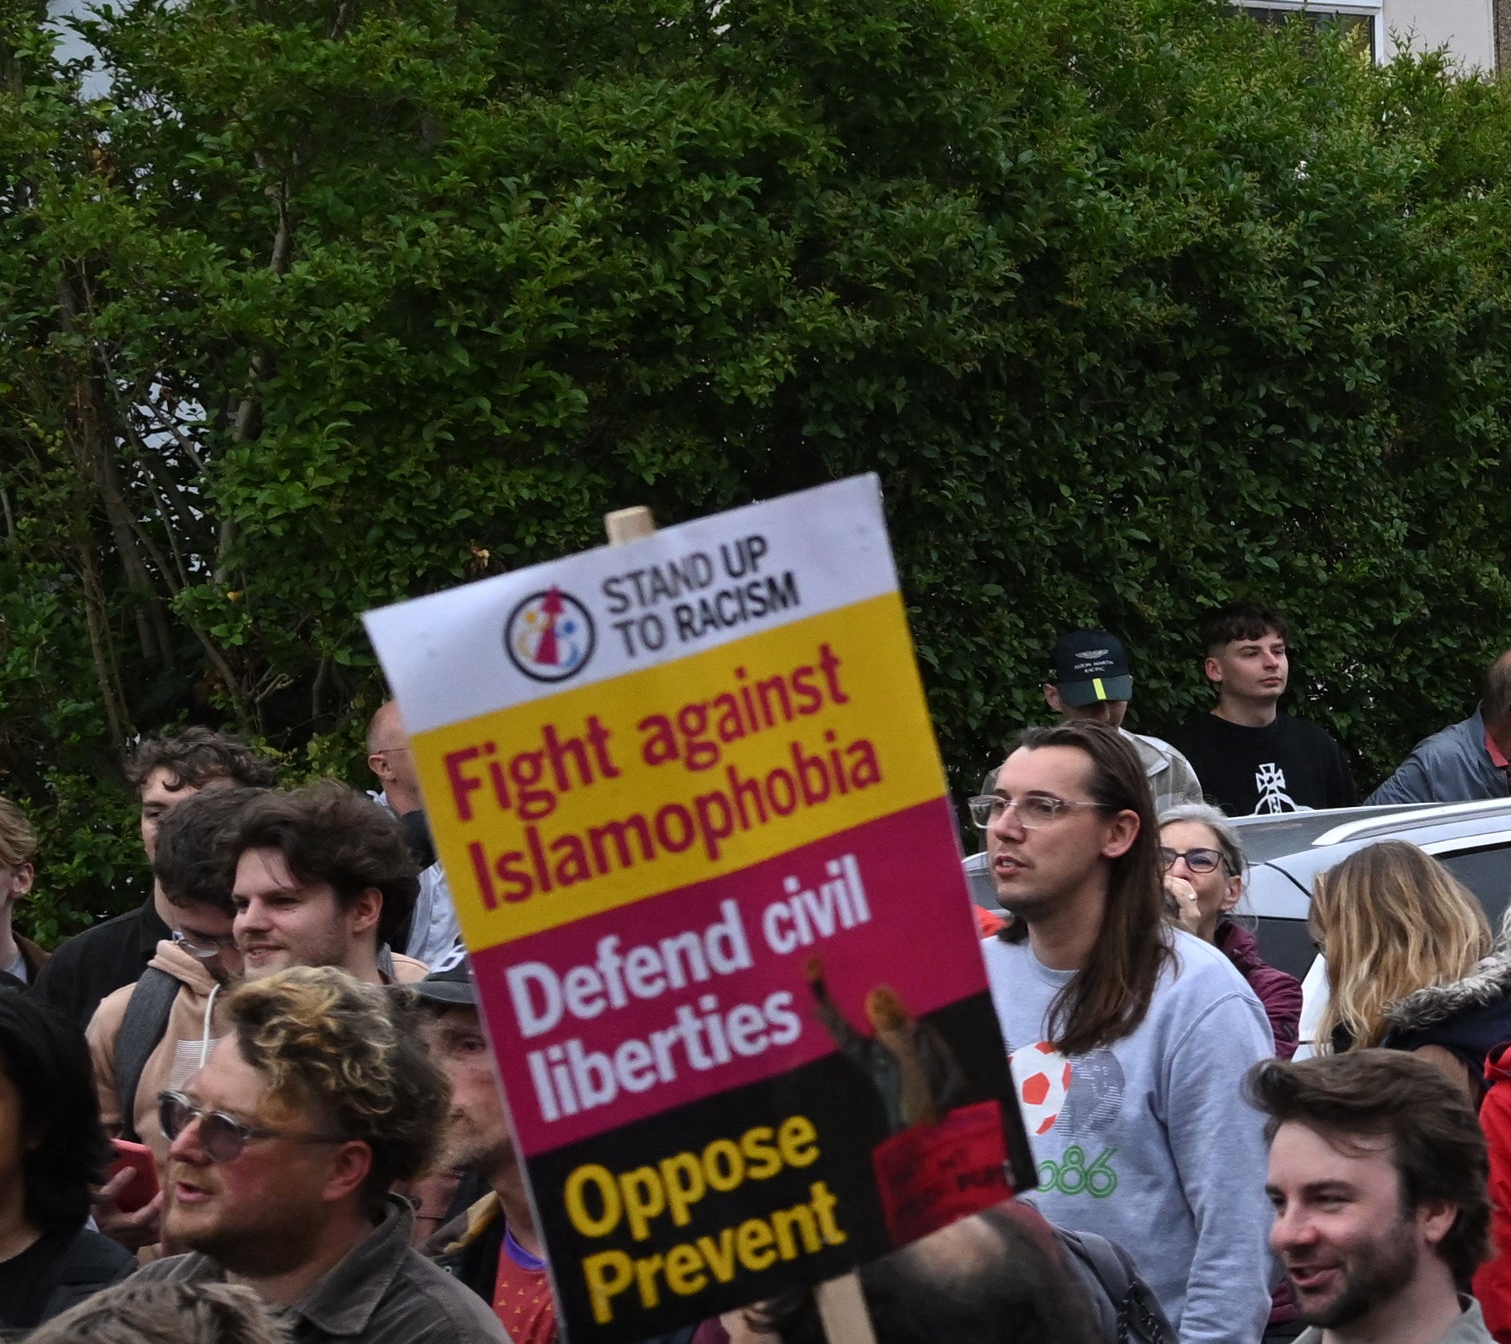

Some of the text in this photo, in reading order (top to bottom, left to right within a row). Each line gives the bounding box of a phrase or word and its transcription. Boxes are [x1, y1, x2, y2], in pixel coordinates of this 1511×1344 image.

[602, 534, 769, 614] STAND UP
[612, 571, 801, 657] TO RACISM
[444, 644, 849, 822] Fight against
[467, 731, 883, 911] Islamophobia
[506, 854, 870, 1038] Defend civil
[523, 991, 802, 1123] liberties
[565, 1114, 819, 1241] Oppose
[581, 1180, 848, 1324] Prevent
